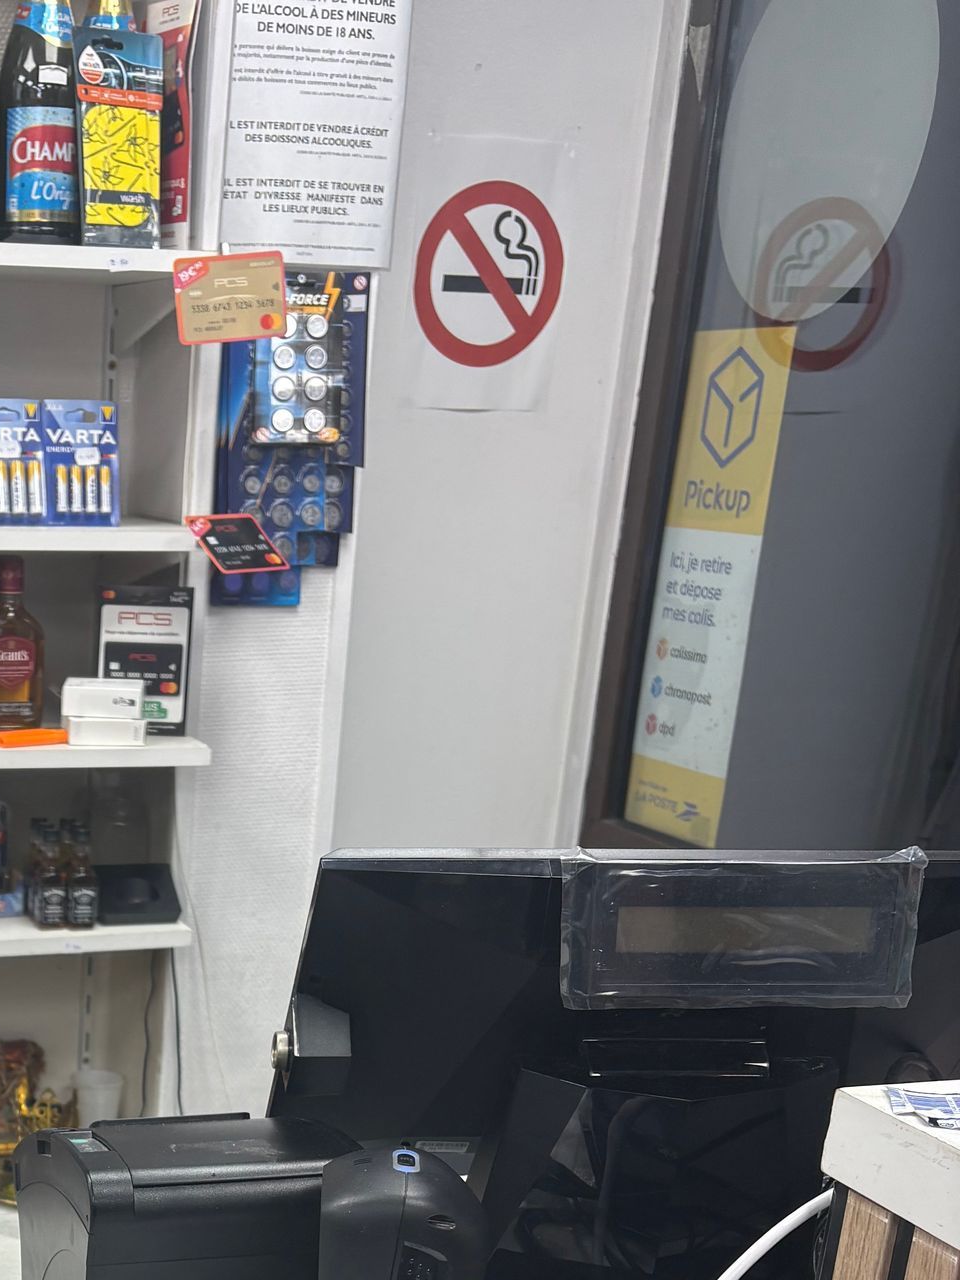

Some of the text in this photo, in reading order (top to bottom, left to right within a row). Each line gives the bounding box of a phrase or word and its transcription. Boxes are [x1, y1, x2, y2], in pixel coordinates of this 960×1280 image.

[251, 3, 397, 25] L'ALCOOL À DES MINEURS
[258, 21, 375, 40] DE MOINS DE 18 ANS.
[237, 121, 389, 137] EST INTERDIT DE VENDRE CRÉDIT
[245, 134, 373, 149] DES BOISSONS ALCOOLIQUES.
[236, 179, 254, 187] EST
[256, 179, 301, 189] INTERDIT
[303, 180, 315, 189] DE
[318, 181, 328, 189] SE
[331, 182, 371, 192] TROUVER
[373, 185, 385, 193] EN
[223, 190, 384, 206] ÉTAT D'IVRESSE MANIFESTE DANS
[263, 204, 350, 216] LES LIEUX PUBLICS.
[214, 276, 249, 288] PCS
[45, 427, 117, 445] VARTA
[684, 480, 751, 518] Pickup
[670, 551, 732, 575] Ici, je retire
[666, 579, 722, 601] et dépose
[117, 611, 172, 626] PCS
[661, 605, 716, 627] mes colis.
[670, 645, 708, 664] colissimo
[664, 684, 713, 706] chronopost
[658, 720, 676, 737] dpd
